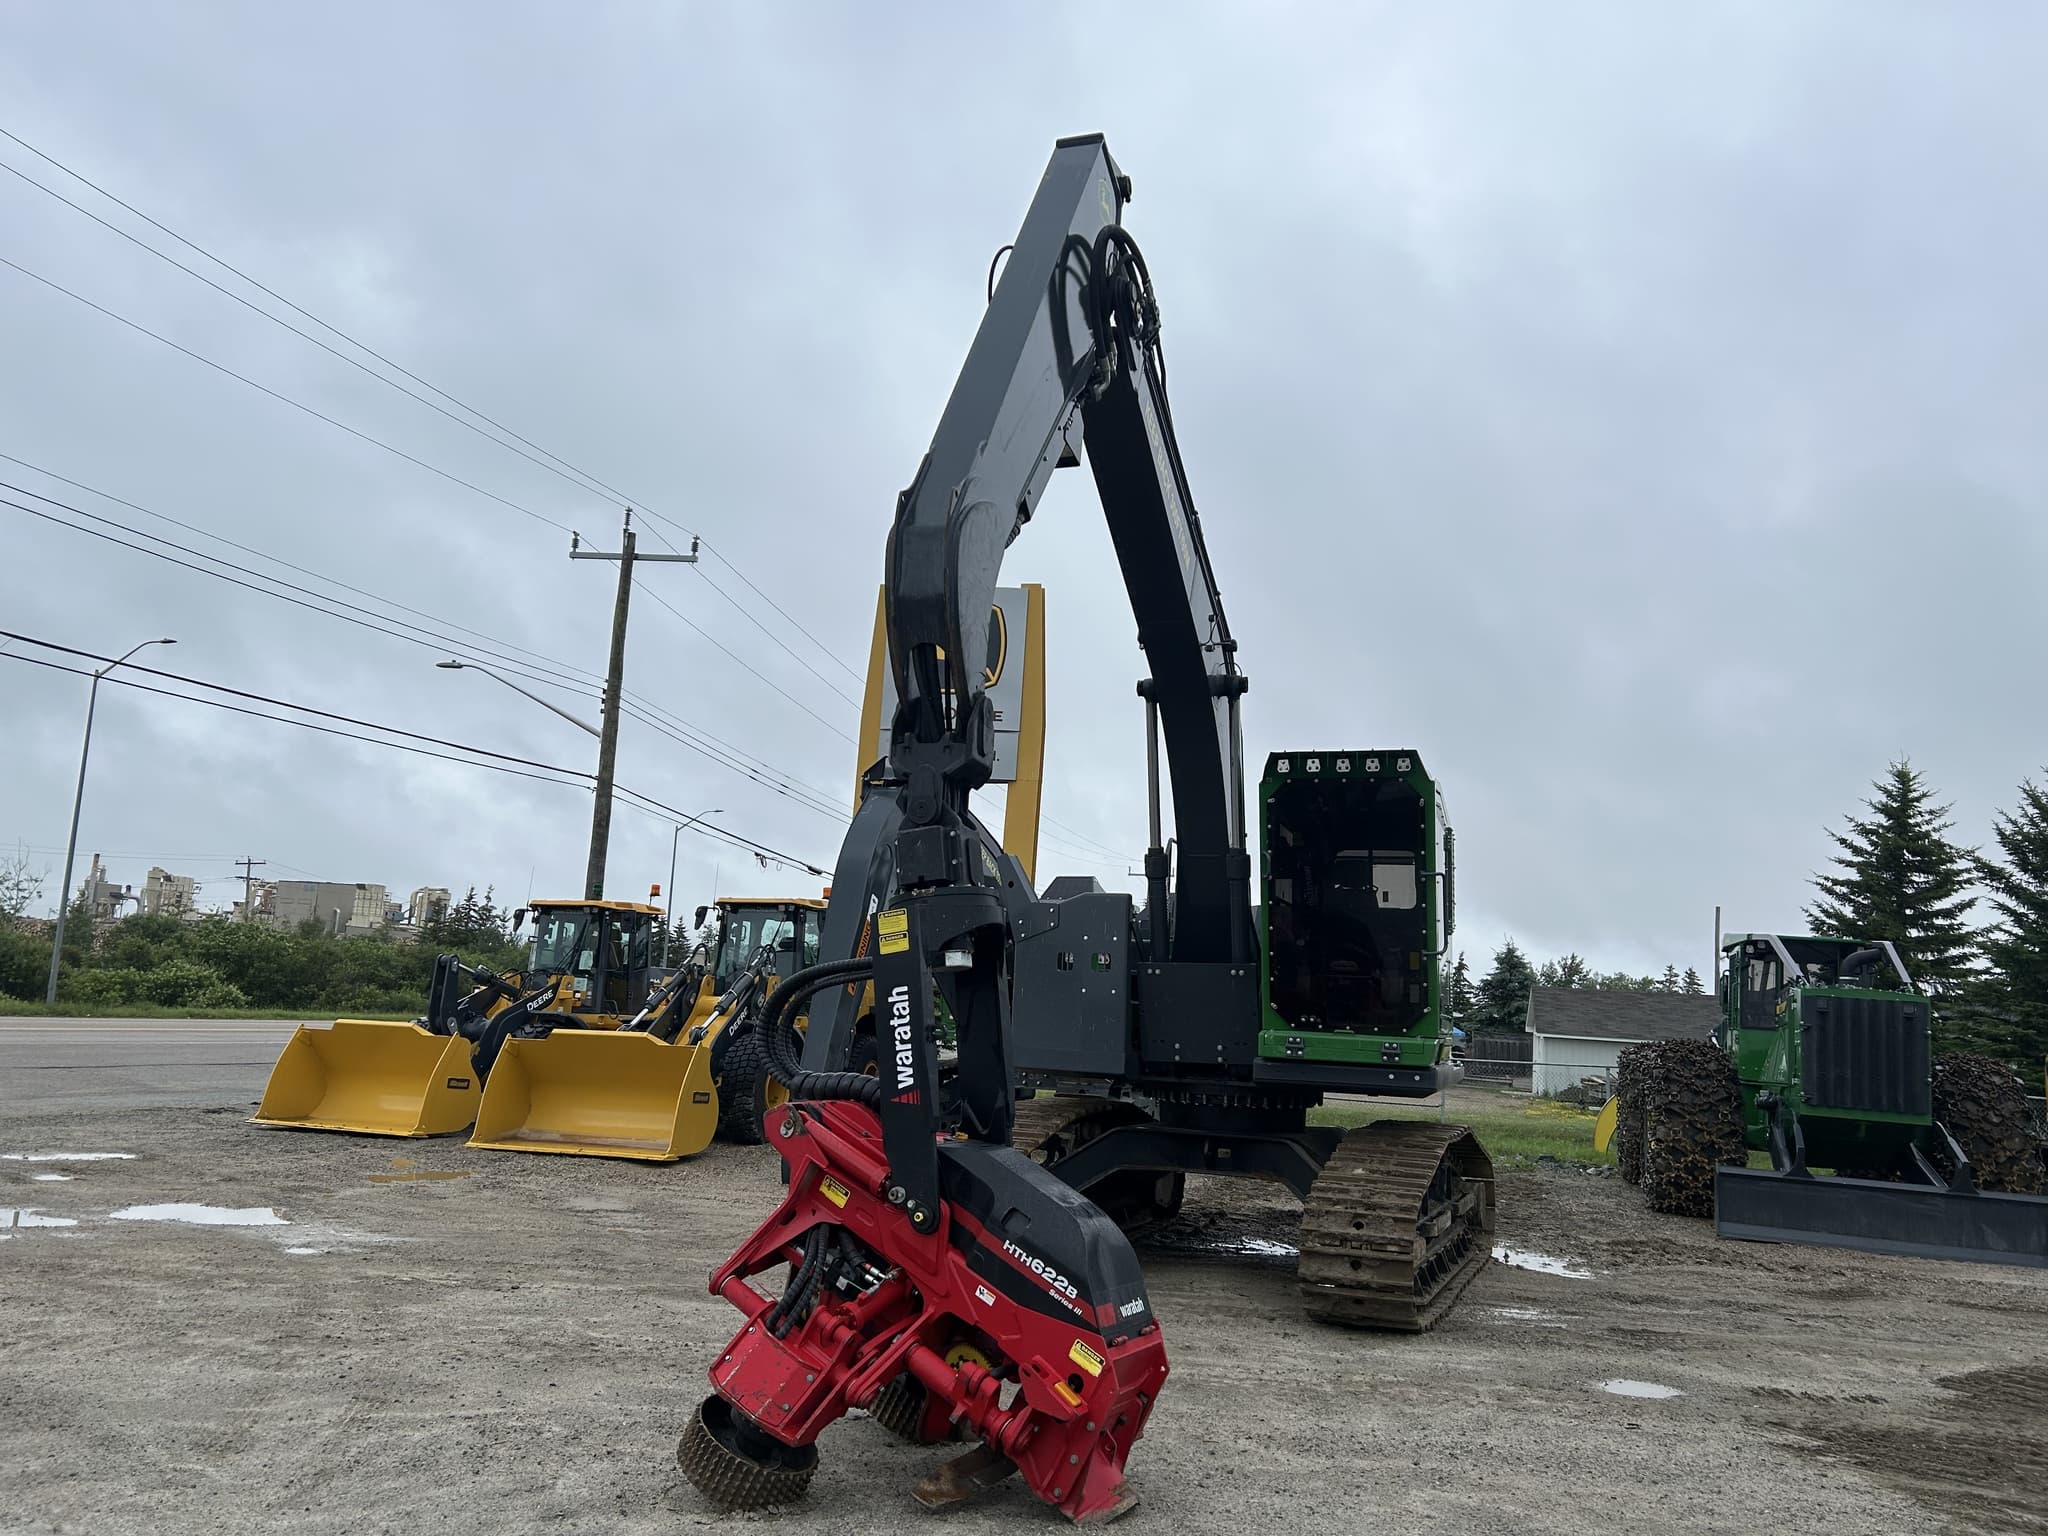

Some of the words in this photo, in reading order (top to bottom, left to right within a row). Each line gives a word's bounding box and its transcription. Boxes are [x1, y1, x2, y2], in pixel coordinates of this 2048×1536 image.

[526, 989, 554, 1011] DEERE
[729, 1006, 748, 1037] DEERE
[888, 985, 914, 1089] waratah
[1003, 1239, 1078, 1299] HTH622B
[1048, 1288, 1073, 1310] Series
[1073, 1306, 1083, 1316] III
[1119, 1296, 1145, 1318] waratah
